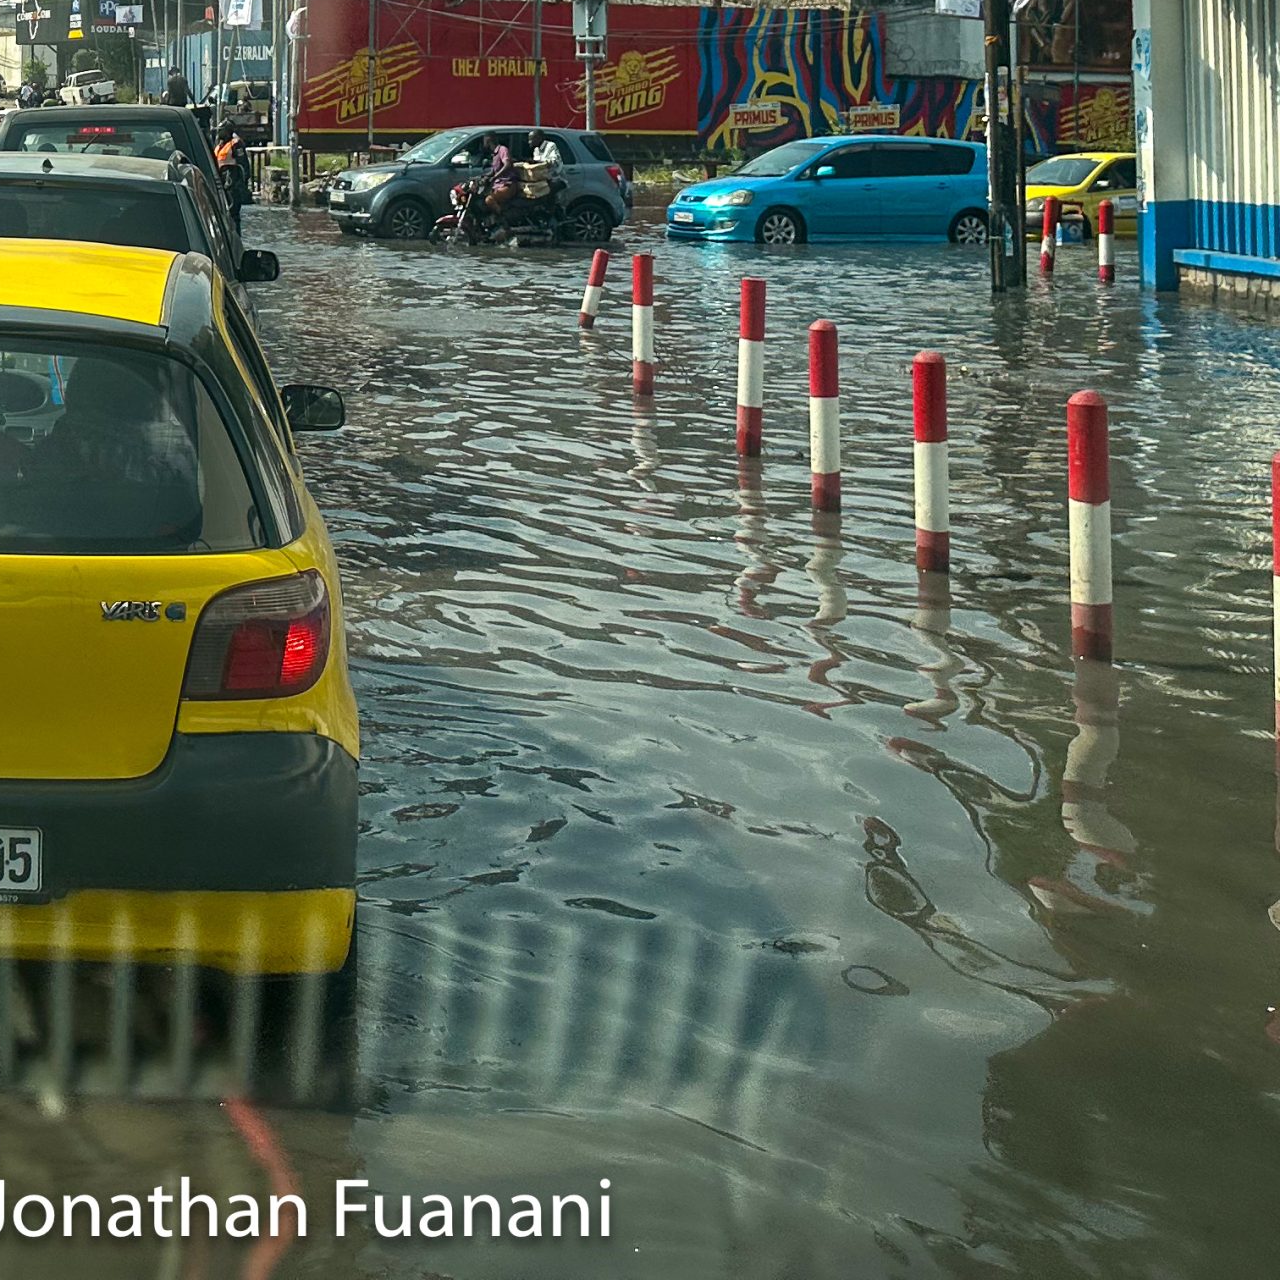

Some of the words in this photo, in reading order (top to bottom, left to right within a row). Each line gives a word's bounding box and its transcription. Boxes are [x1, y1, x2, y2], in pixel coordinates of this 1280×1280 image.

[90, 24, 128, 34] SOUDAL
[223, 46, 242, 61] CEZ
[452, 57, 481, 77] CHEZ
[609, 85, 662, 118] KING
[733, 109, 777, 125] PRIMUS
[854, 112, 895, 127] PRIMUS
[100, 601, 162, 622] YARIS
